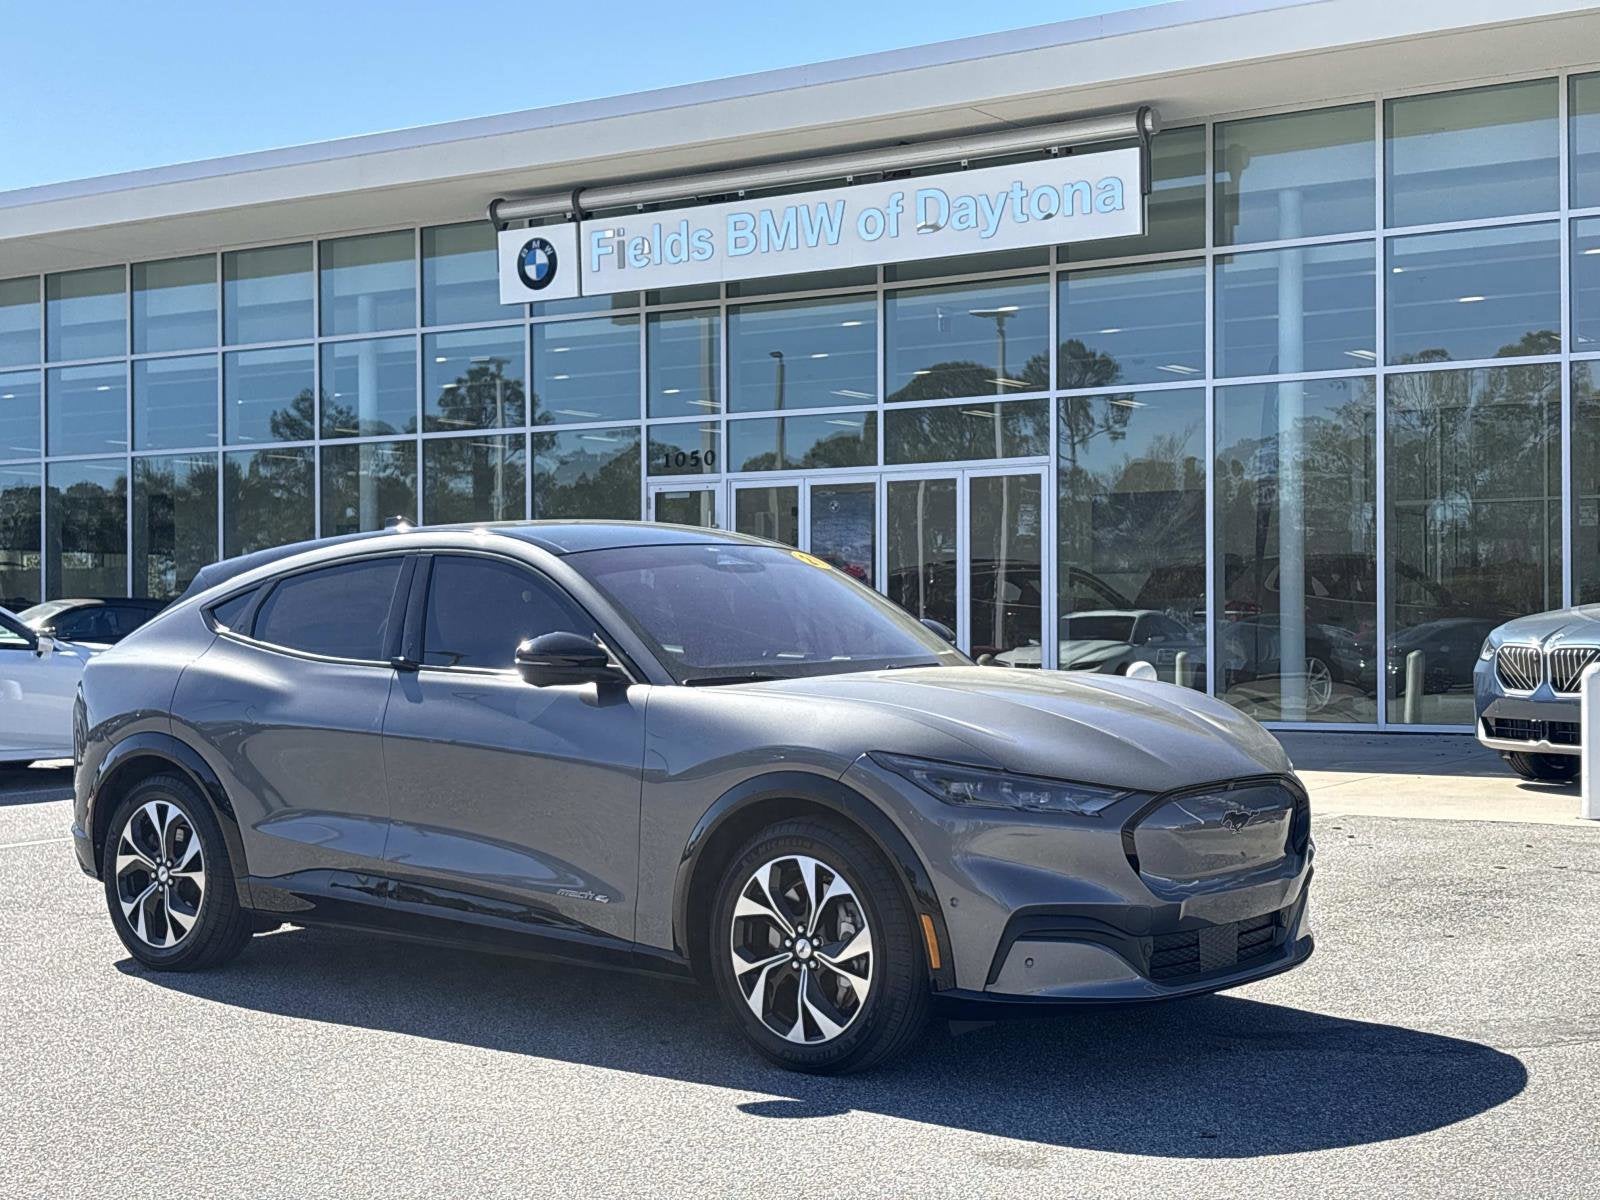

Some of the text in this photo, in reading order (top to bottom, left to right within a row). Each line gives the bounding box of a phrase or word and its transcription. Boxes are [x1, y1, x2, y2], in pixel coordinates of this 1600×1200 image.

[590, 175, 1125, 273] Fields BMW of Daytona
[520, 239, 554, 258] BMW
[663, 449, 716, 468] 1050
